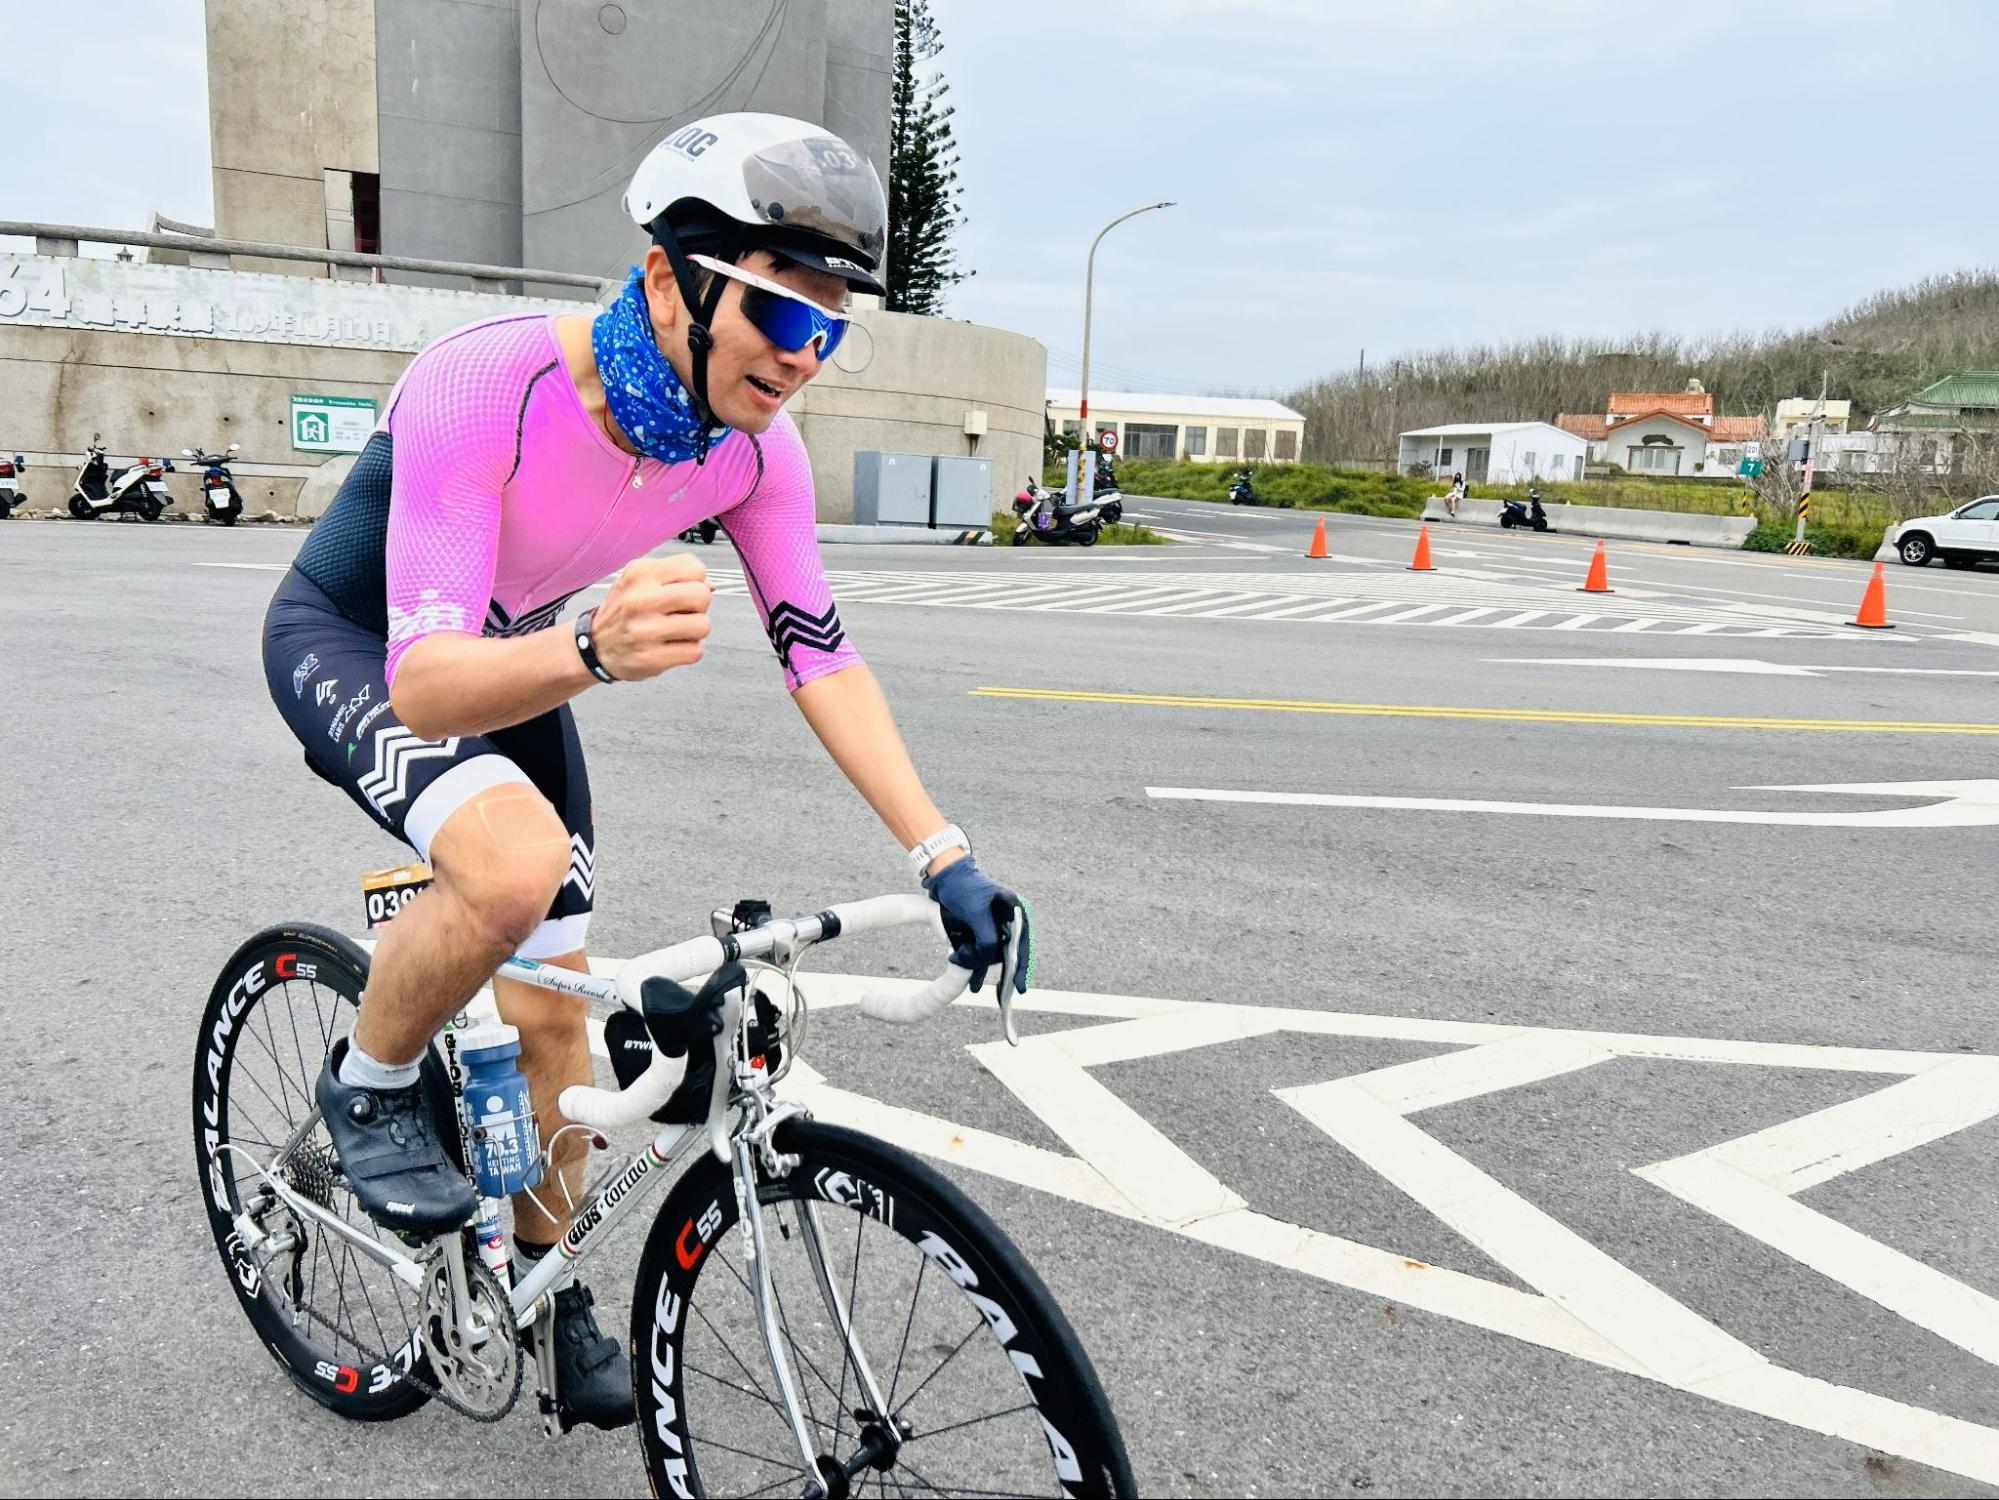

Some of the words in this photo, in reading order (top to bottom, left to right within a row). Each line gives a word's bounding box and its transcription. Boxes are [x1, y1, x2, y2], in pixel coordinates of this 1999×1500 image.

[1103, 436, 1115, 445] 70
[1747, 463, 1755, 473] 7
[368, 887, 422, 920] 039
[544, 975, 571, 992] Super
[574, 981, 610, 1000] Record
[489, 1161, 522, 1177] TAWAN
